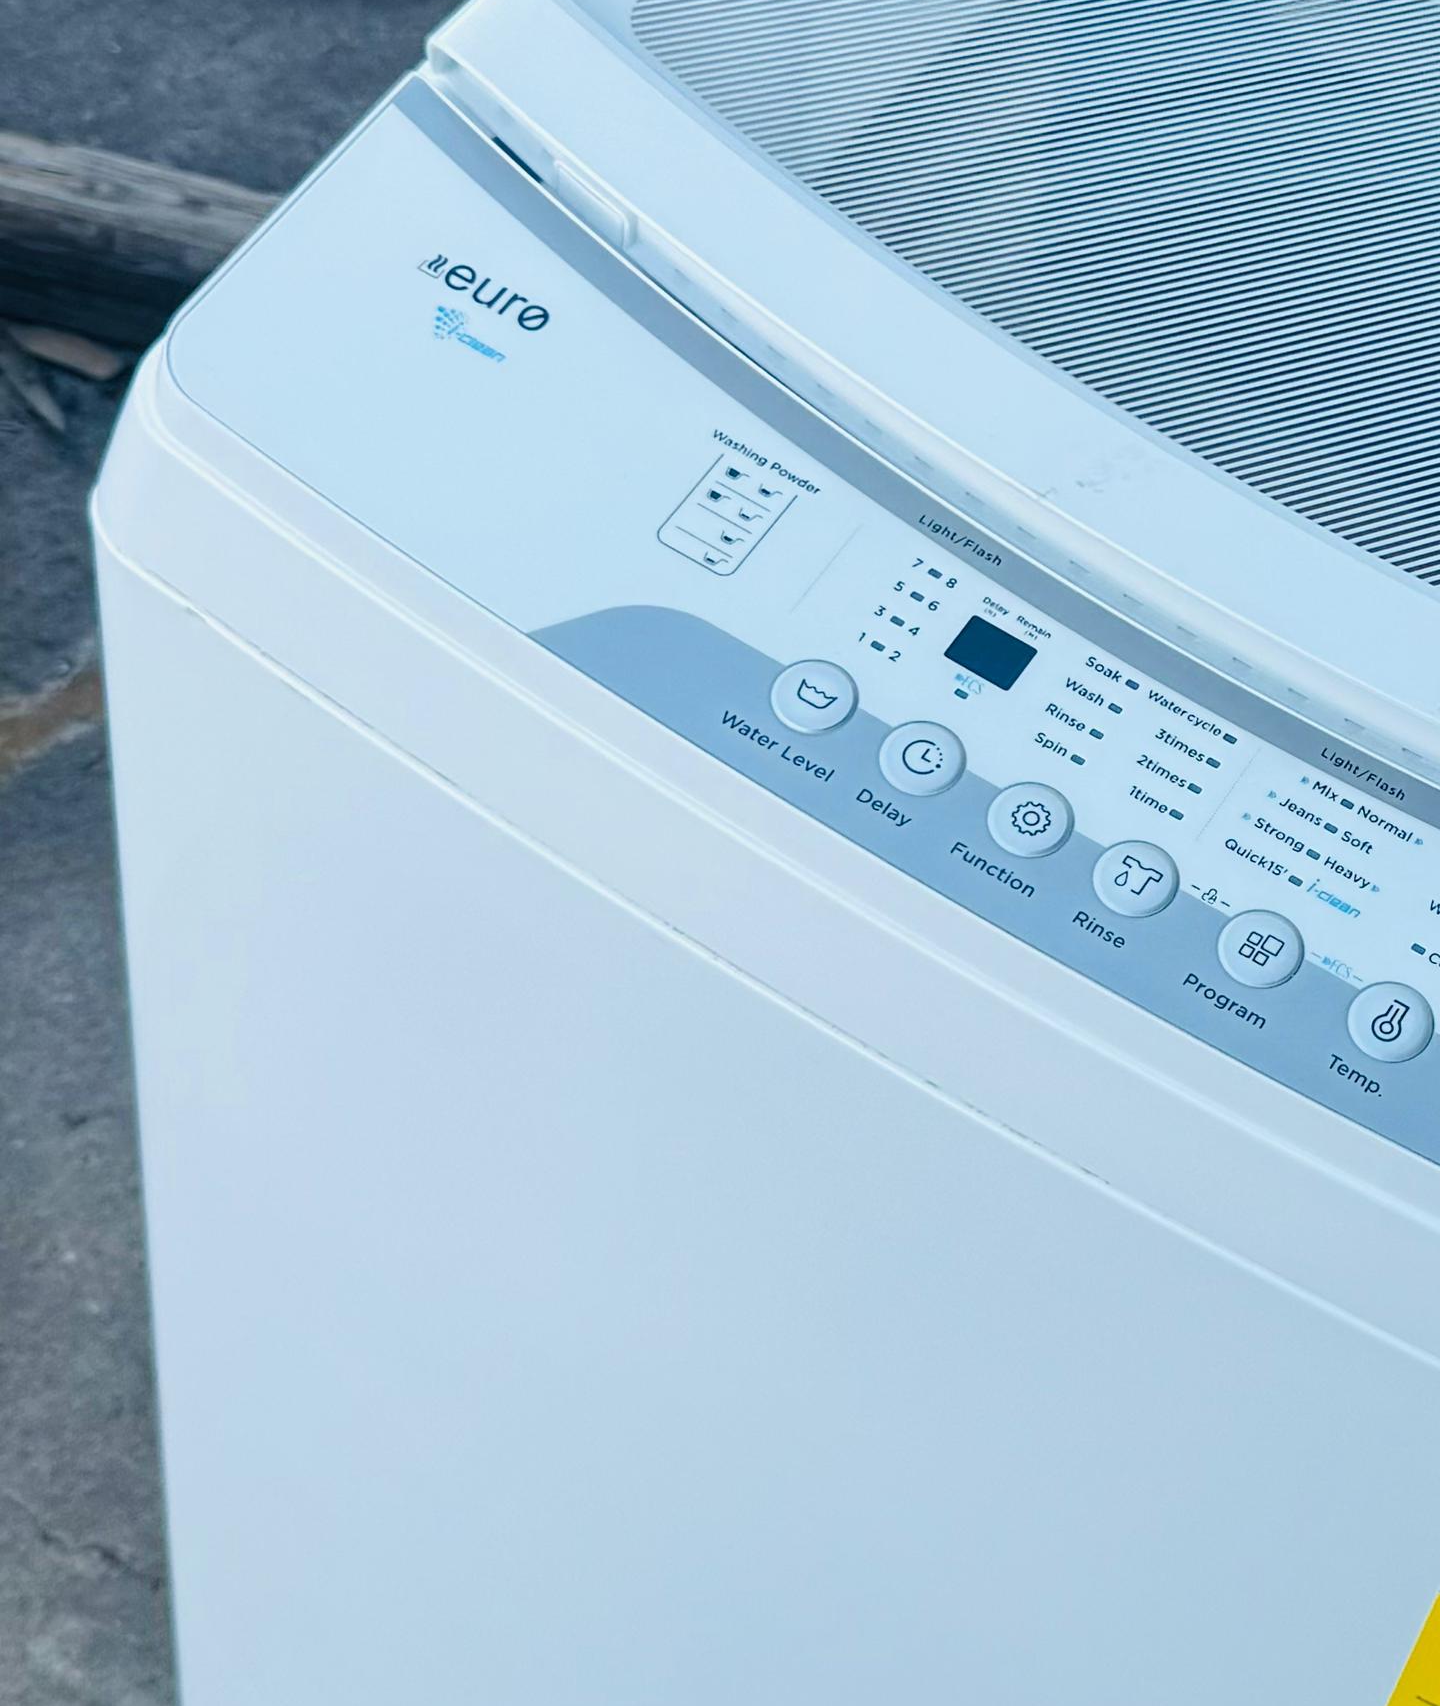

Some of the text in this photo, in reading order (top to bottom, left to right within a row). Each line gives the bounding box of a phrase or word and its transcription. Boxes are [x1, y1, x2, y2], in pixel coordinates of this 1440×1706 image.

[713, 429, 821, 496] Washing Powder
[918, 514, 1002, 567] Light/Flash
[911, 558, 958, 589] 7 8
[893, 581, 941, 612] 5 6
[874, 605, 920, 637] 3 4
[1016, 615, 1052, 639] Remain
[859, 633, 901, 662] 1 2
[1085, 656, 1123, 683] Soak
[1065, 677, 1104, 706] Wash
[1045, 703, 1086, 732] Rinse
[721, 710, 836, 783] Water Level
[1034, 732, 1068, 758] Spin
[1155, 728, 1205, 762] 3times
[1137, 754, 1187, 788] 2times
[1320, 747, 1406, 801] Light/Flash
[855, 789, 912, 829] Delay
[1129, 785, 1168, 814] 1time
[1312, 780, 1414, 843] Mix Normal
[1279, 798, 1373, 855] Jeans Soft
[950, 842, 1036, 898] Function
[1254, 817, 1372, 889] Strong Heavy
[1072, 910, 1126, 949] Rinse
[1182, 973, 1267, 1030] Program
[1328, 1054, 1382, 1097] Temp.
